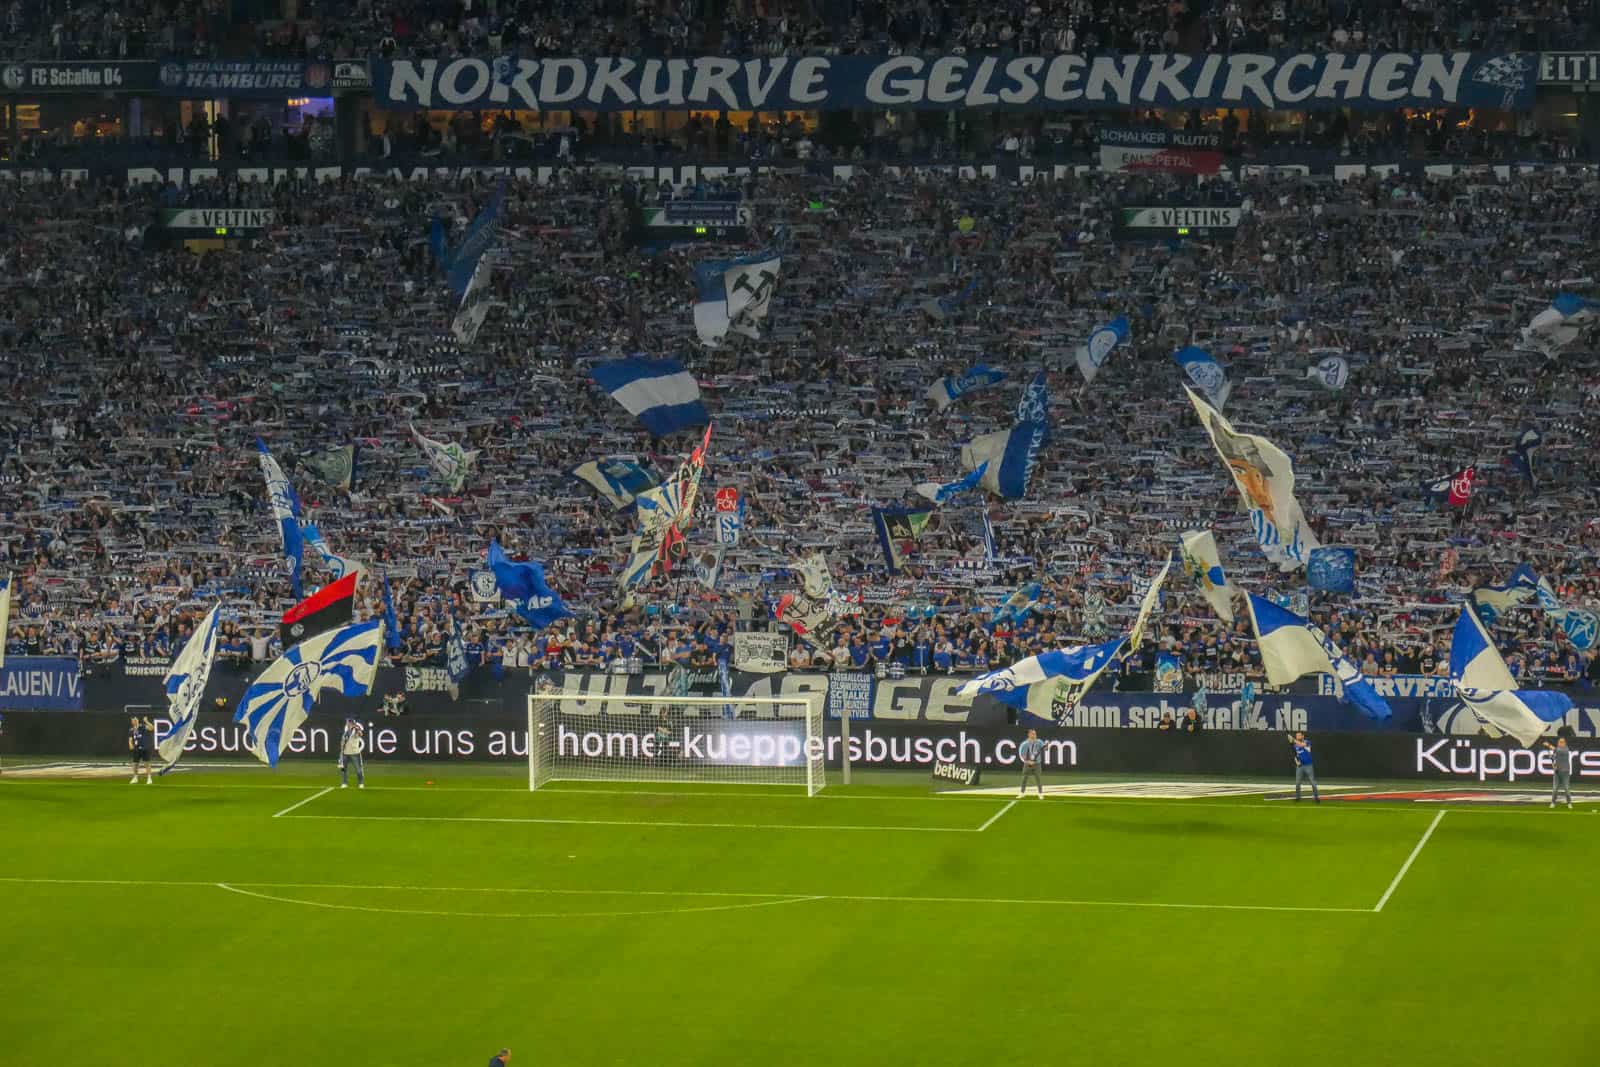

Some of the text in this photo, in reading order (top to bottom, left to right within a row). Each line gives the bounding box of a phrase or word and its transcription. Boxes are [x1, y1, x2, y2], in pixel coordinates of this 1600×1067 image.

[31, 67, 122, 86] FC Schalke 04
[186, 73, 302, 89] HAMBURG
[388, 52, 1471, 111] NORDKURVE GELSENKIRCHEN
[1101, 128, 1167, 144] SCHALKER
[202, 209, 273, 226] VELTINS
[1162, 210, 1231, 226] VELTINS
[830, 690, 870, 700] SCALKE
[873, 676, 976, 722] GE
[411, 728, 475, 755] uns
[488, 720, 546, 756] au
[934, 759, 976, 785] betway
